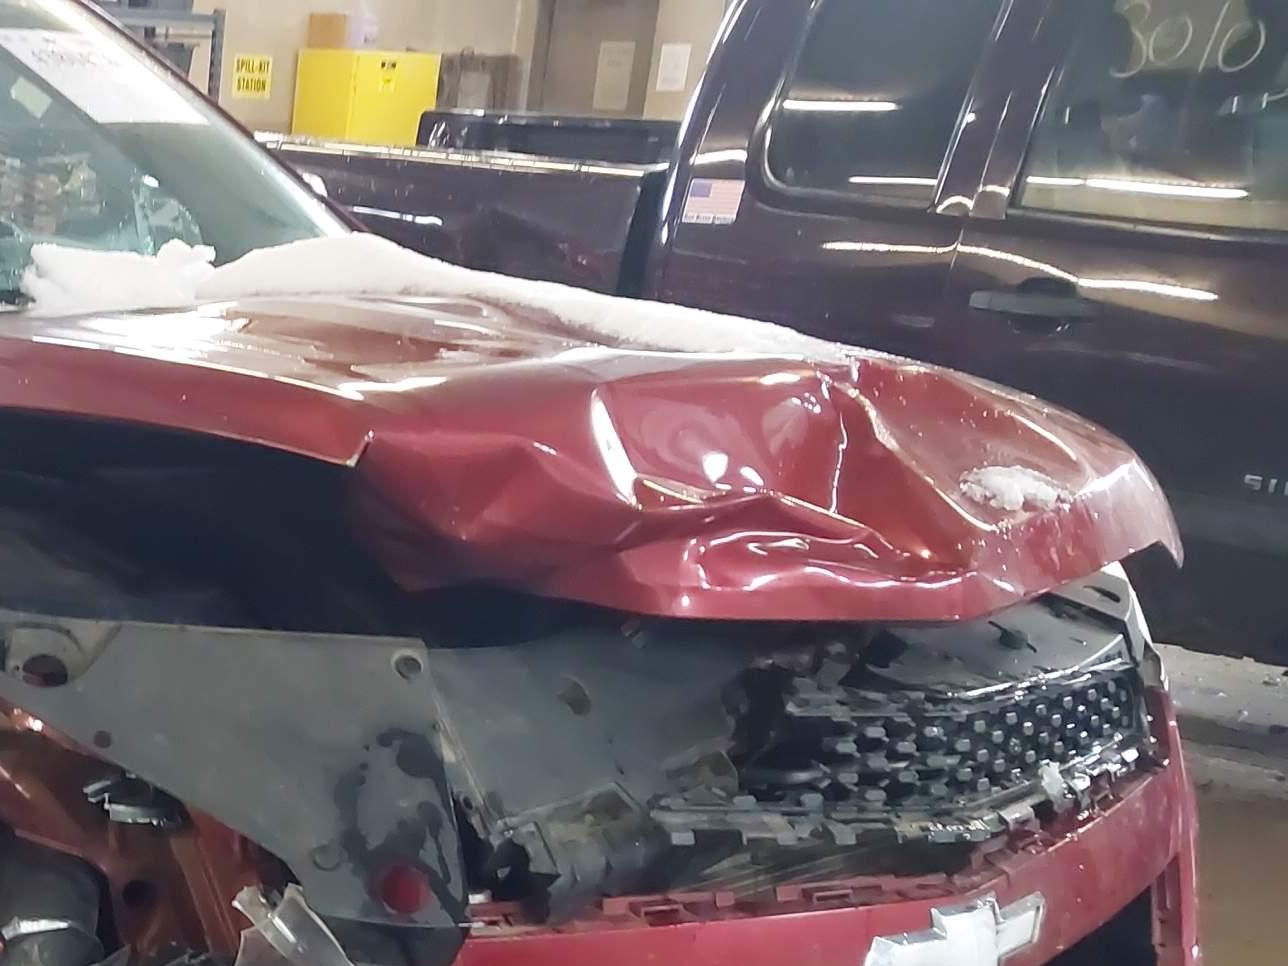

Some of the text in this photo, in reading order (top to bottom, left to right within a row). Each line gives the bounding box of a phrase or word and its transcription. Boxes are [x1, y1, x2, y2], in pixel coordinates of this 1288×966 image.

[1109, 1, 1266, 78] 3010
[236, 59, 270, 73] SPILL-KIT
[237, 77, 267, 92] STATION
